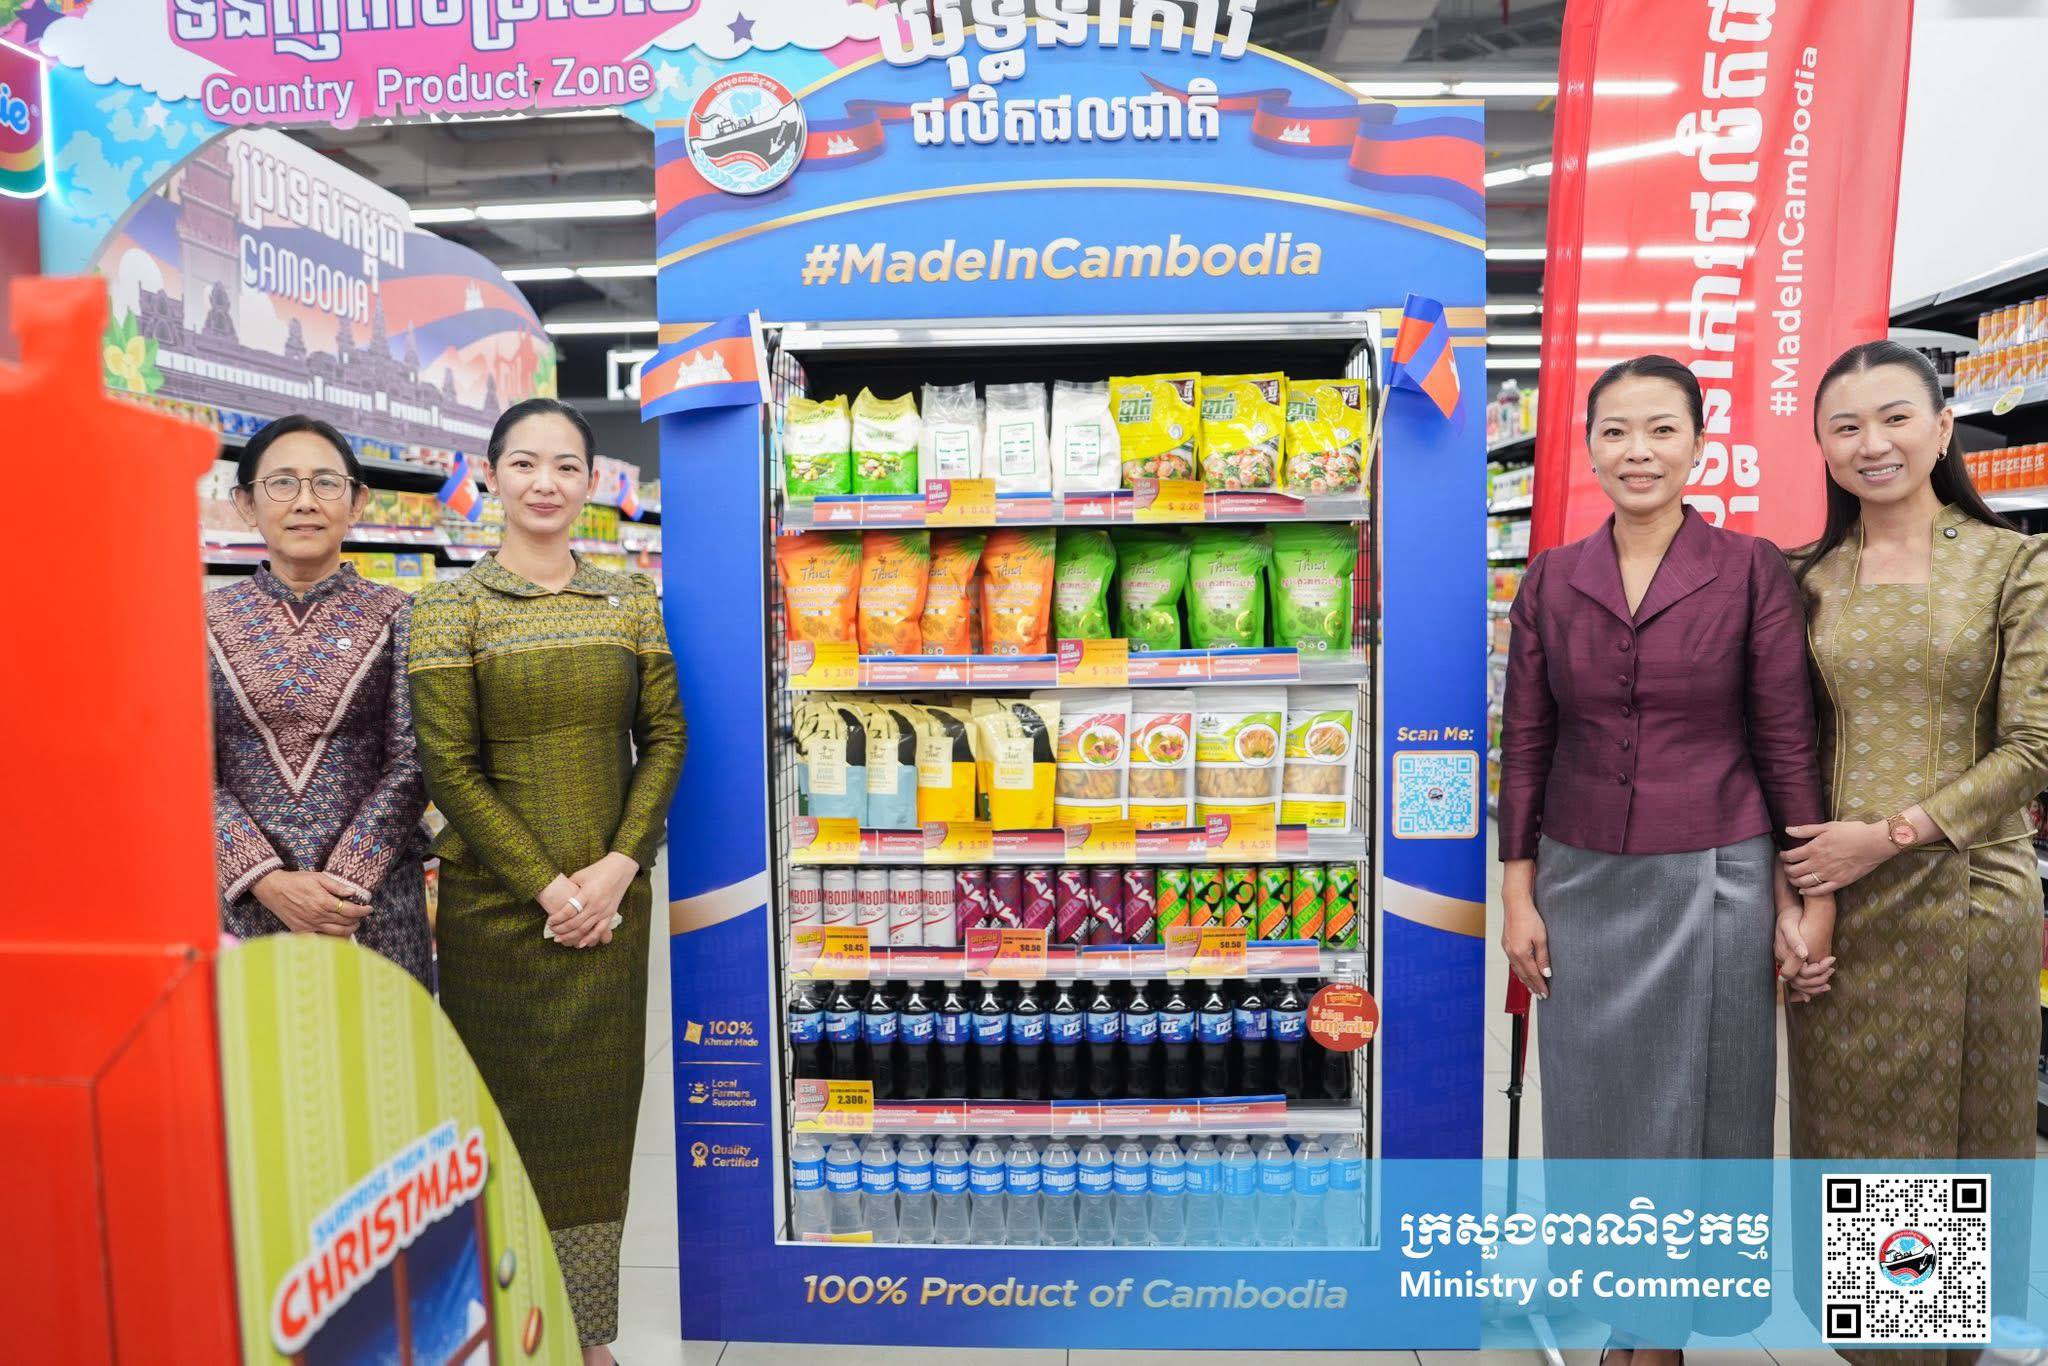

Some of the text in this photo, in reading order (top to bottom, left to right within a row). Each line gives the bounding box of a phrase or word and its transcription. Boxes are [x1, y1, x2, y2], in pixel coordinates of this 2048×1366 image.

[204, 56, 652, 120] Country Product Zone
[1769, 46, 1818, 417] #MadeInCambodia
[801, 232, 1322, 286] #MadeInCambodia
[239, 234, 369, 325] CAMBODIA
[1396, 726, 1474, 741] Scan Me:
[709, 1021, 753, 1036] 100%
[914, 1019, 933, 1036] IZE
[1024, 1020, 1043, 1037] IZE
[1160, 1020, 1179, 1034] IZE
[1280, 1019, 1300, 1033] IZE
[704, 1038, 758, 1047] Khmer Made
[712, 1080, 737, 1088] Local
[712, 1089, 750, 1098] Farmers
[712, 1098, 757, 1107] Supported
[712, 1145, 751, 1156] Quality
[712, 1157, 759, 1168] Certified
[280, 1135, 484, 1338] CHRISTMAS
[803, 1274, 1349, 1310] 100% Product of Cambodia
